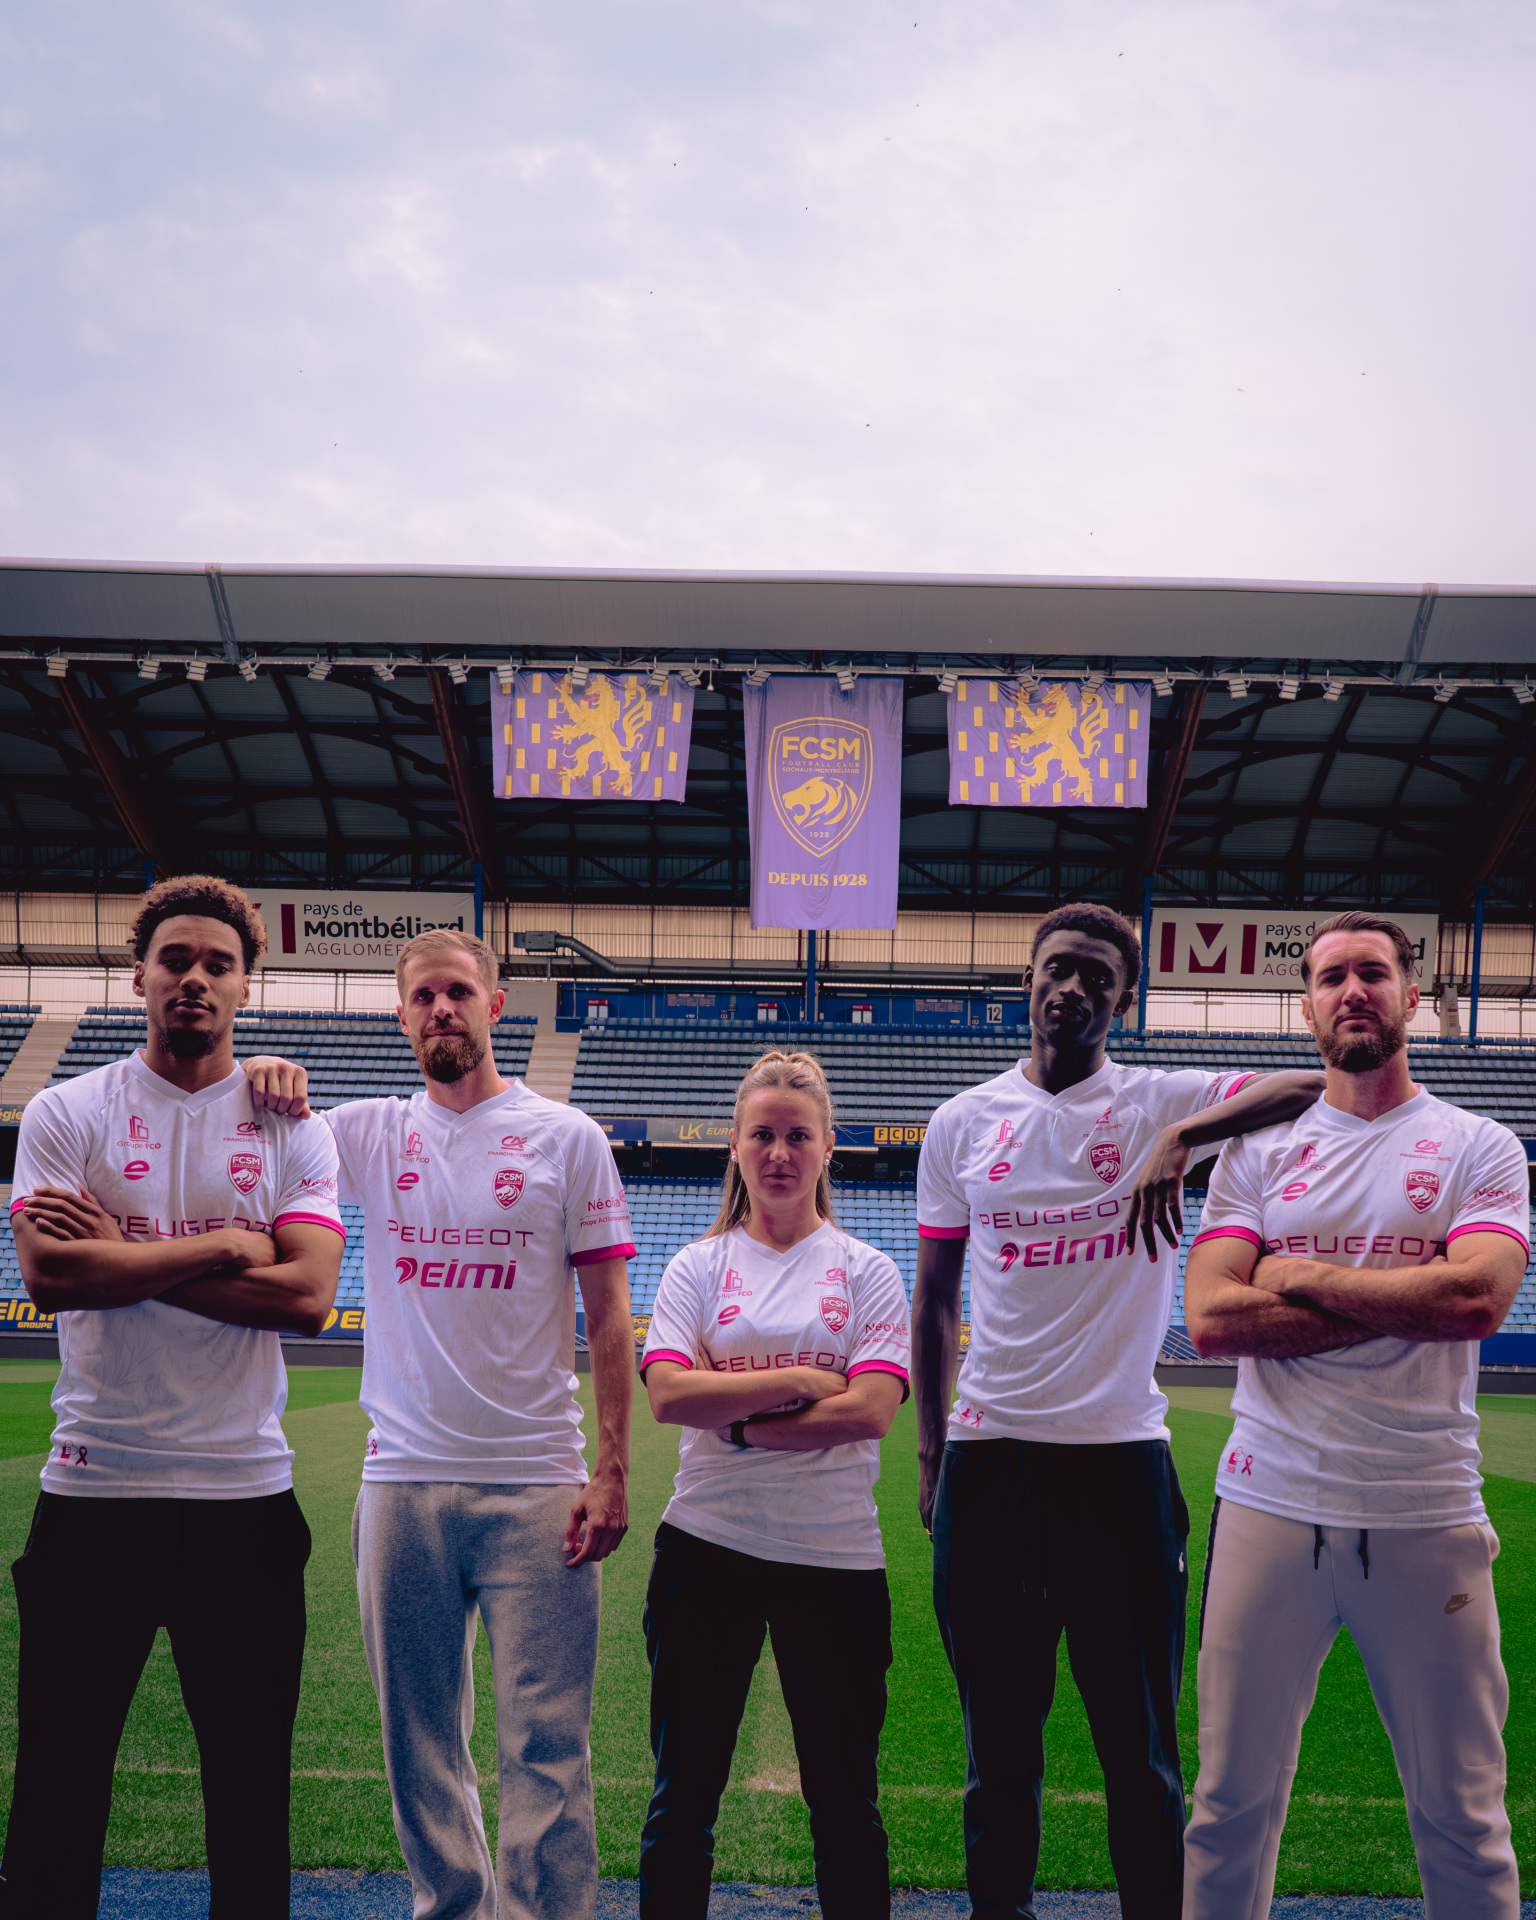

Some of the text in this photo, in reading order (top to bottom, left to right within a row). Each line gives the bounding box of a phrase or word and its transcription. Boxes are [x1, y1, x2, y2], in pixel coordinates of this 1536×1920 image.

[782, 736, 861, 760] FCSM
[768, 871, 868, 887] DEPUIS 1928
[303, 901, 363, 919] Pays de
[1266, 924, 1302, 940] Pays
[987, 1006, 1001, 1022] 12
[679, 1122, 730, 1140] LK EUR
[145, 1142, 162, 1150] FCO
[1091, 1146, 1118, 1158] FCSM
[232, 1156, 261, 1166] FCSM
[415, 1156, 430, 1164] FCO
[498, 1173, 523, 1182] FCSM
[1409, 1173, 1438, 1184] FCSM
[823, 1299, 848, 1310] FCSM
[17, 1321, 54, 1329] GROUPE
